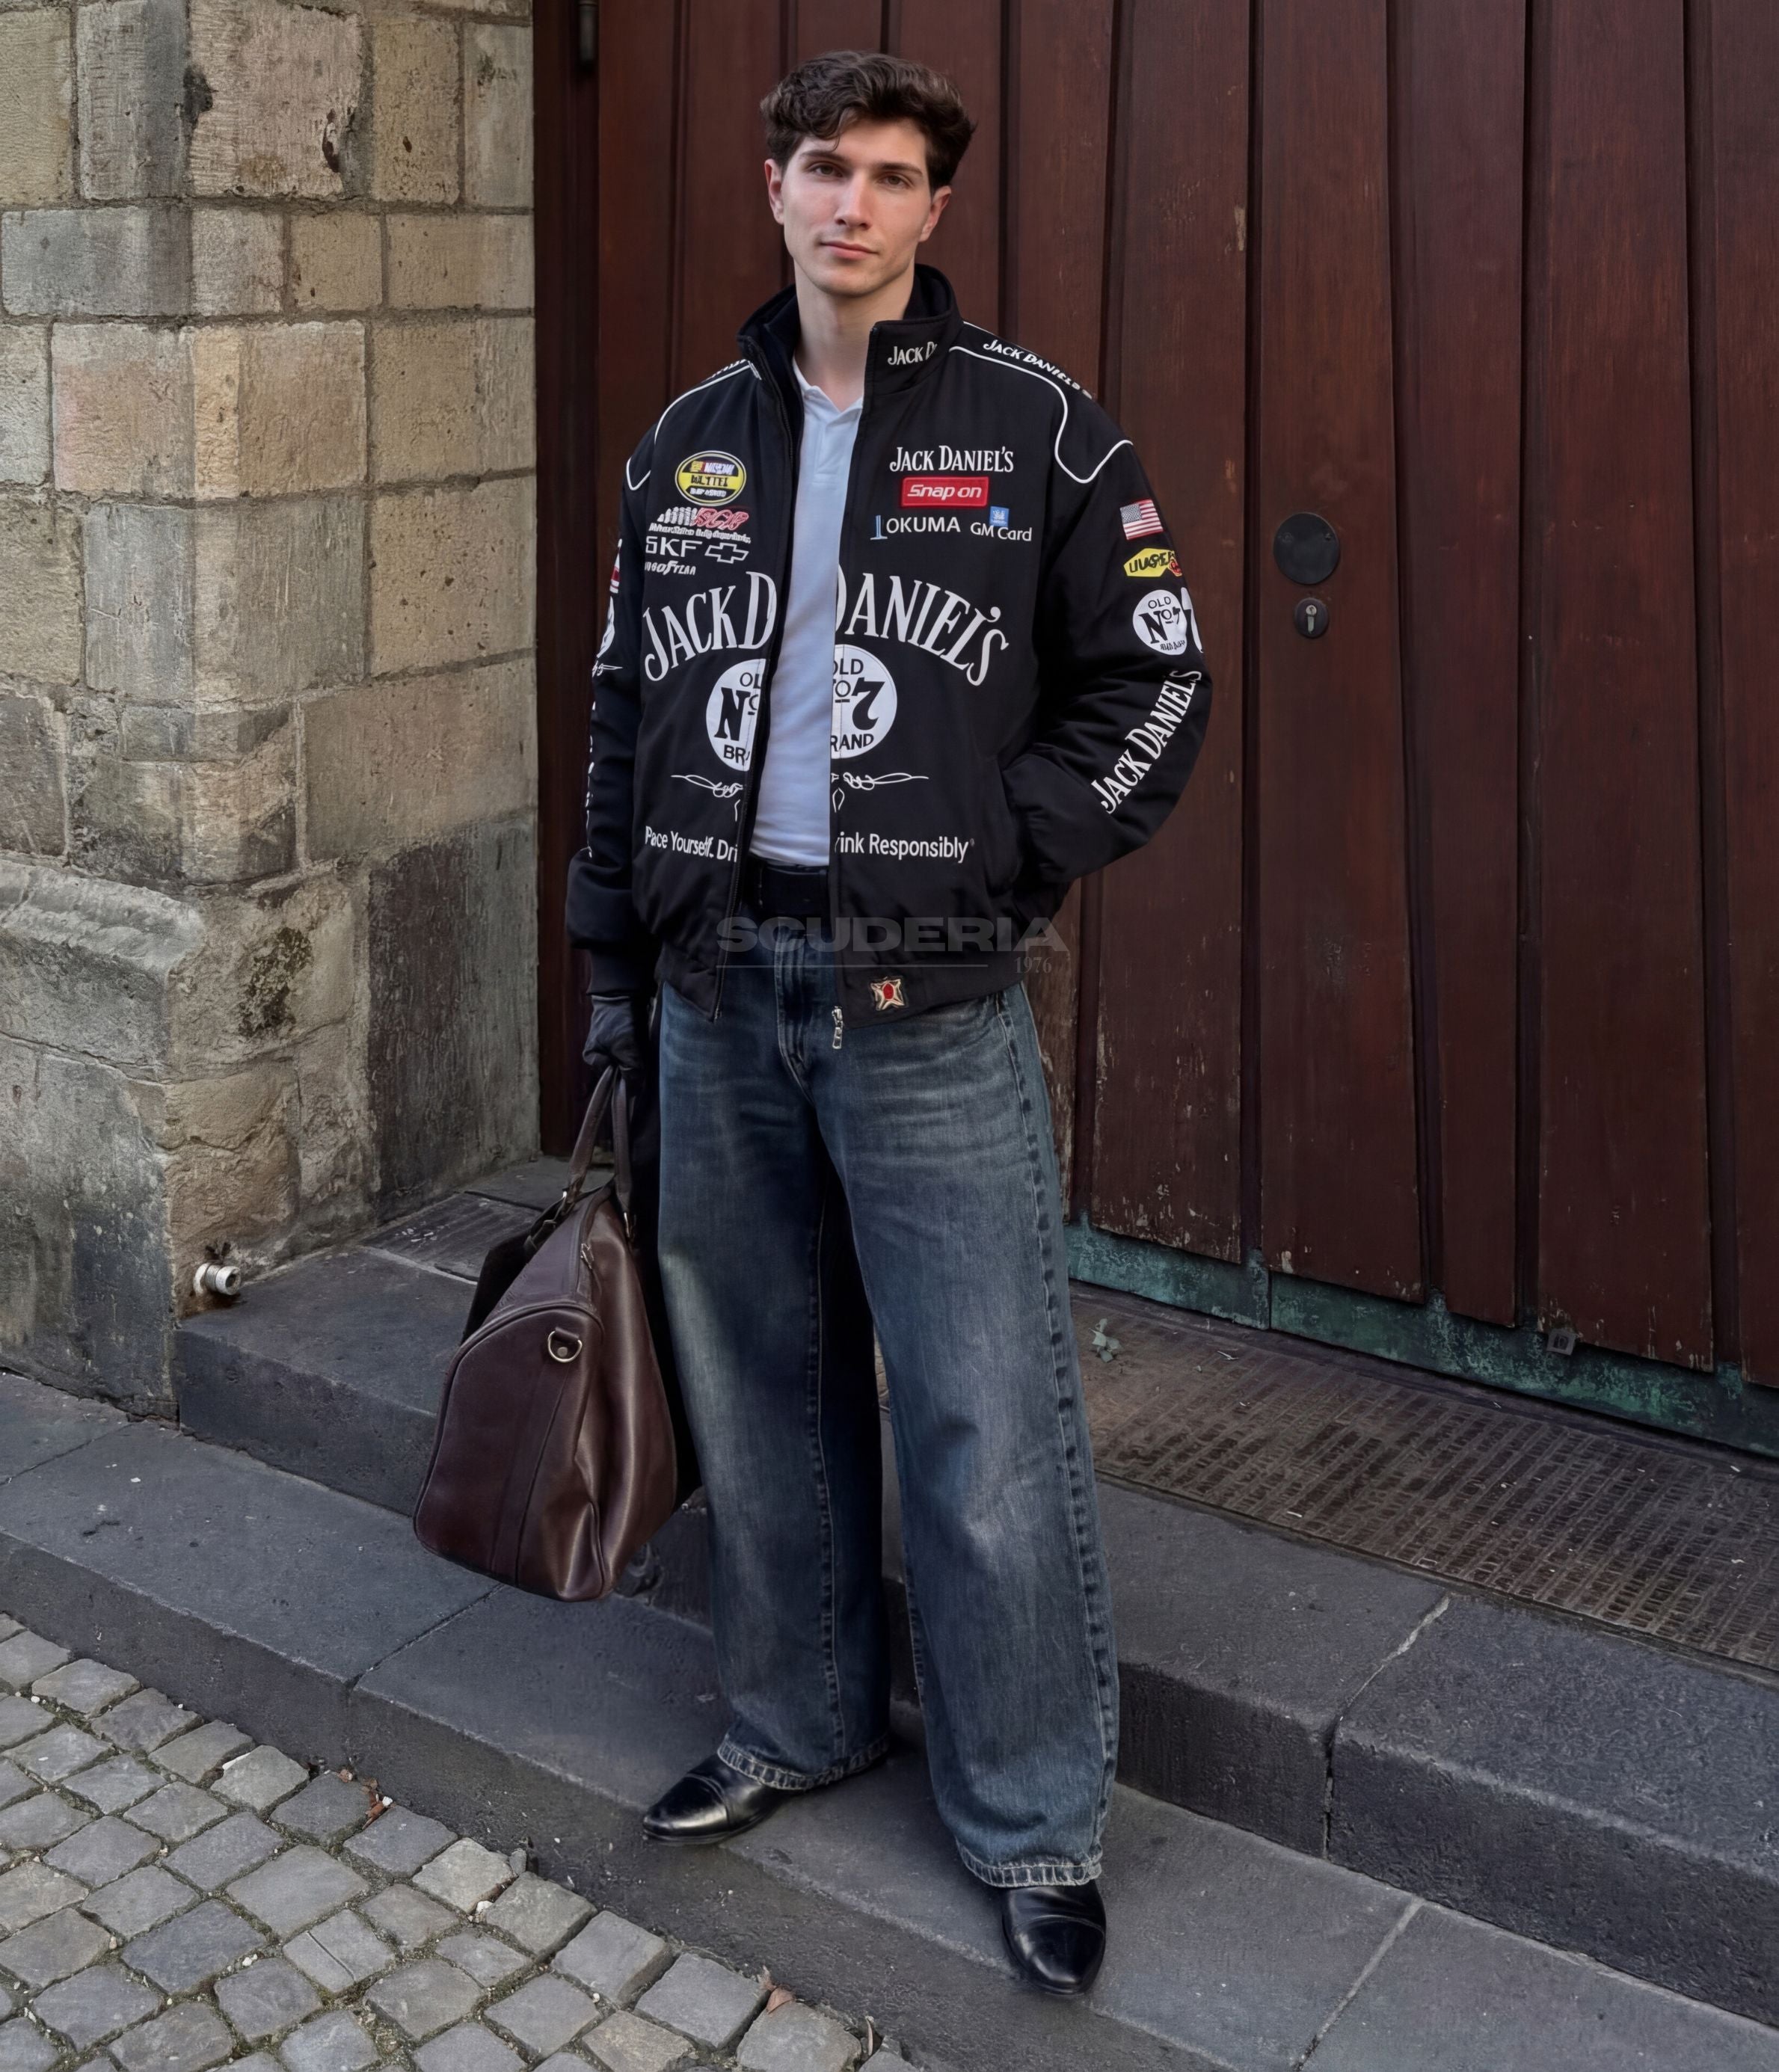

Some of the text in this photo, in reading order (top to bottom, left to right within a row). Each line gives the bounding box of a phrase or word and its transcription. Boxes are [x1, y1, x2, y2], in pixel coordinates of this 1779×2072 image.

[888, 345, 924, 365] JACK
[983, 339, 1025, 360] JACK
[889, 445, 1015, 473] JACK DANIEL'S
[886, 517, 962, 534] OKUMA
[970, 522, 1033, 542] GM Card
[645, 536, 703, 558] SKF
[1148, 596, 1172, 609] OLD
[642, 584, 738, 682] JACK
[851, 677, 885, 731] 7
[1090, 748, 1152, 814] JACK
[645, 826, 669, 849] Pace
[835, 831, 864, 854] ink
